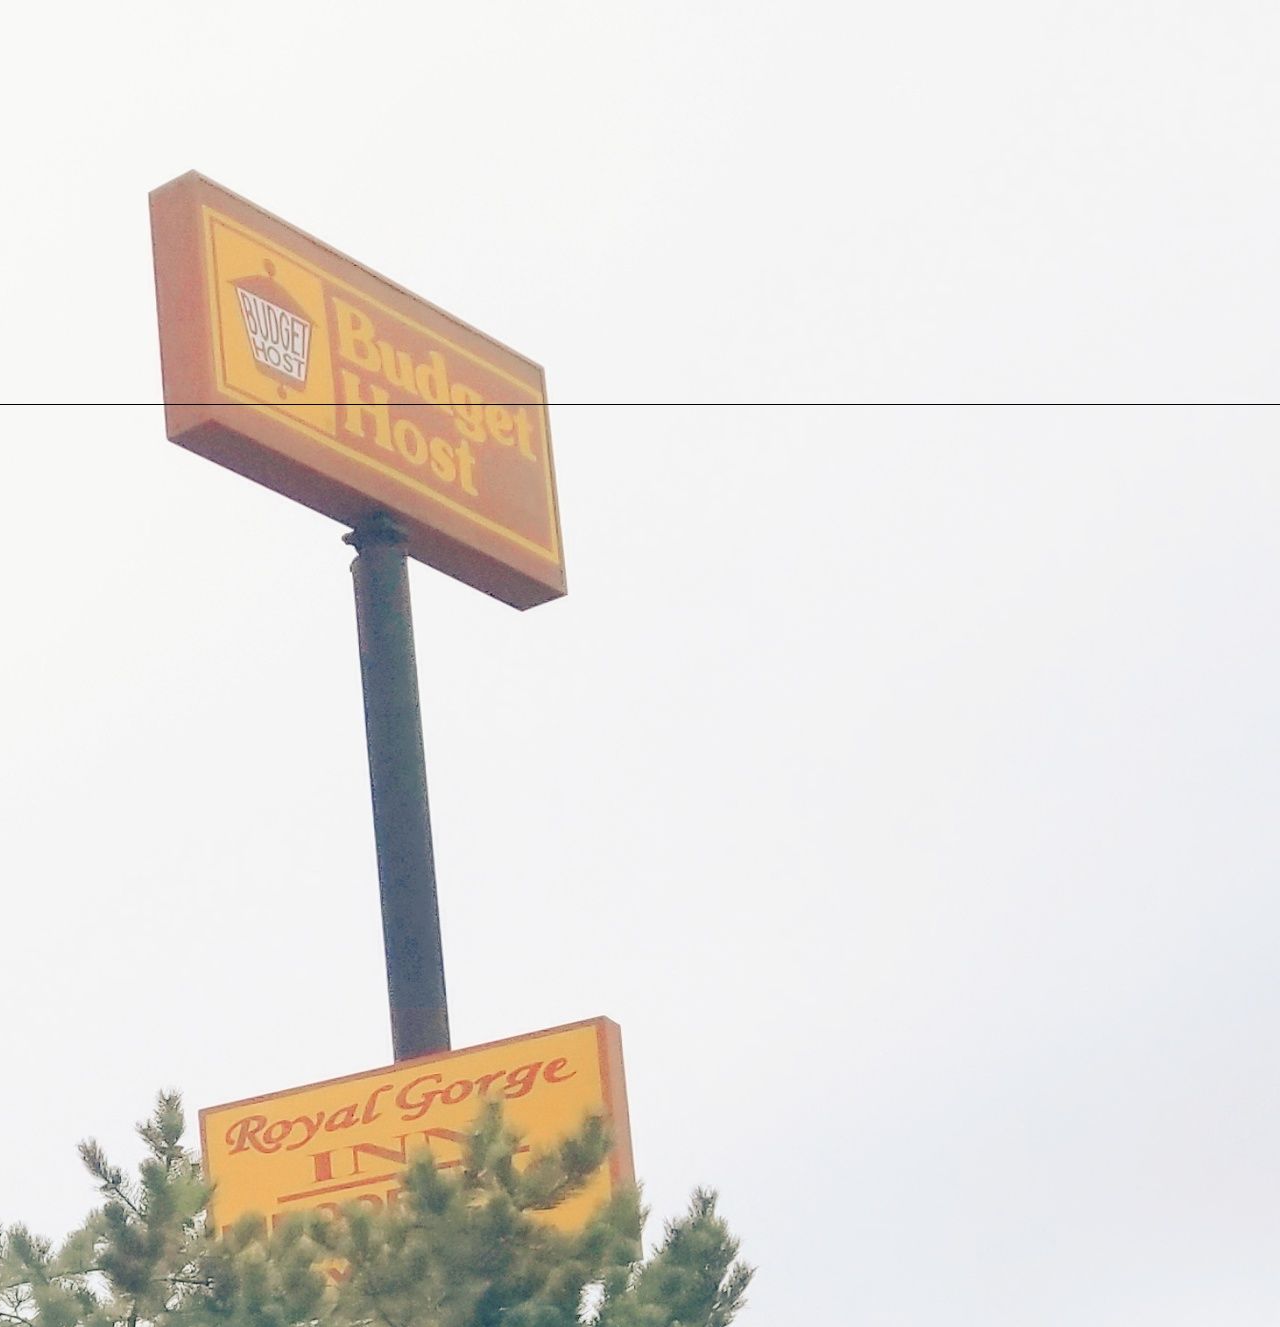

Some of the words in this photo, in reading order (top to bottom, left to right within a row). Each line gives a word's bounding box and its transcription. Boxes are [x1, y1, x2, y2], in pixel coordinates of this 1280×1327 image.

[241, 292, 308, 359] BUDGET
[252, 337, 305, 377] HOST
[333, 297, 536, 462] Budget
[342, 370, 479, 496] Host
[225, 1085, 394, 1155] Royal
[395, 1057, 576, 1121] Gorge
